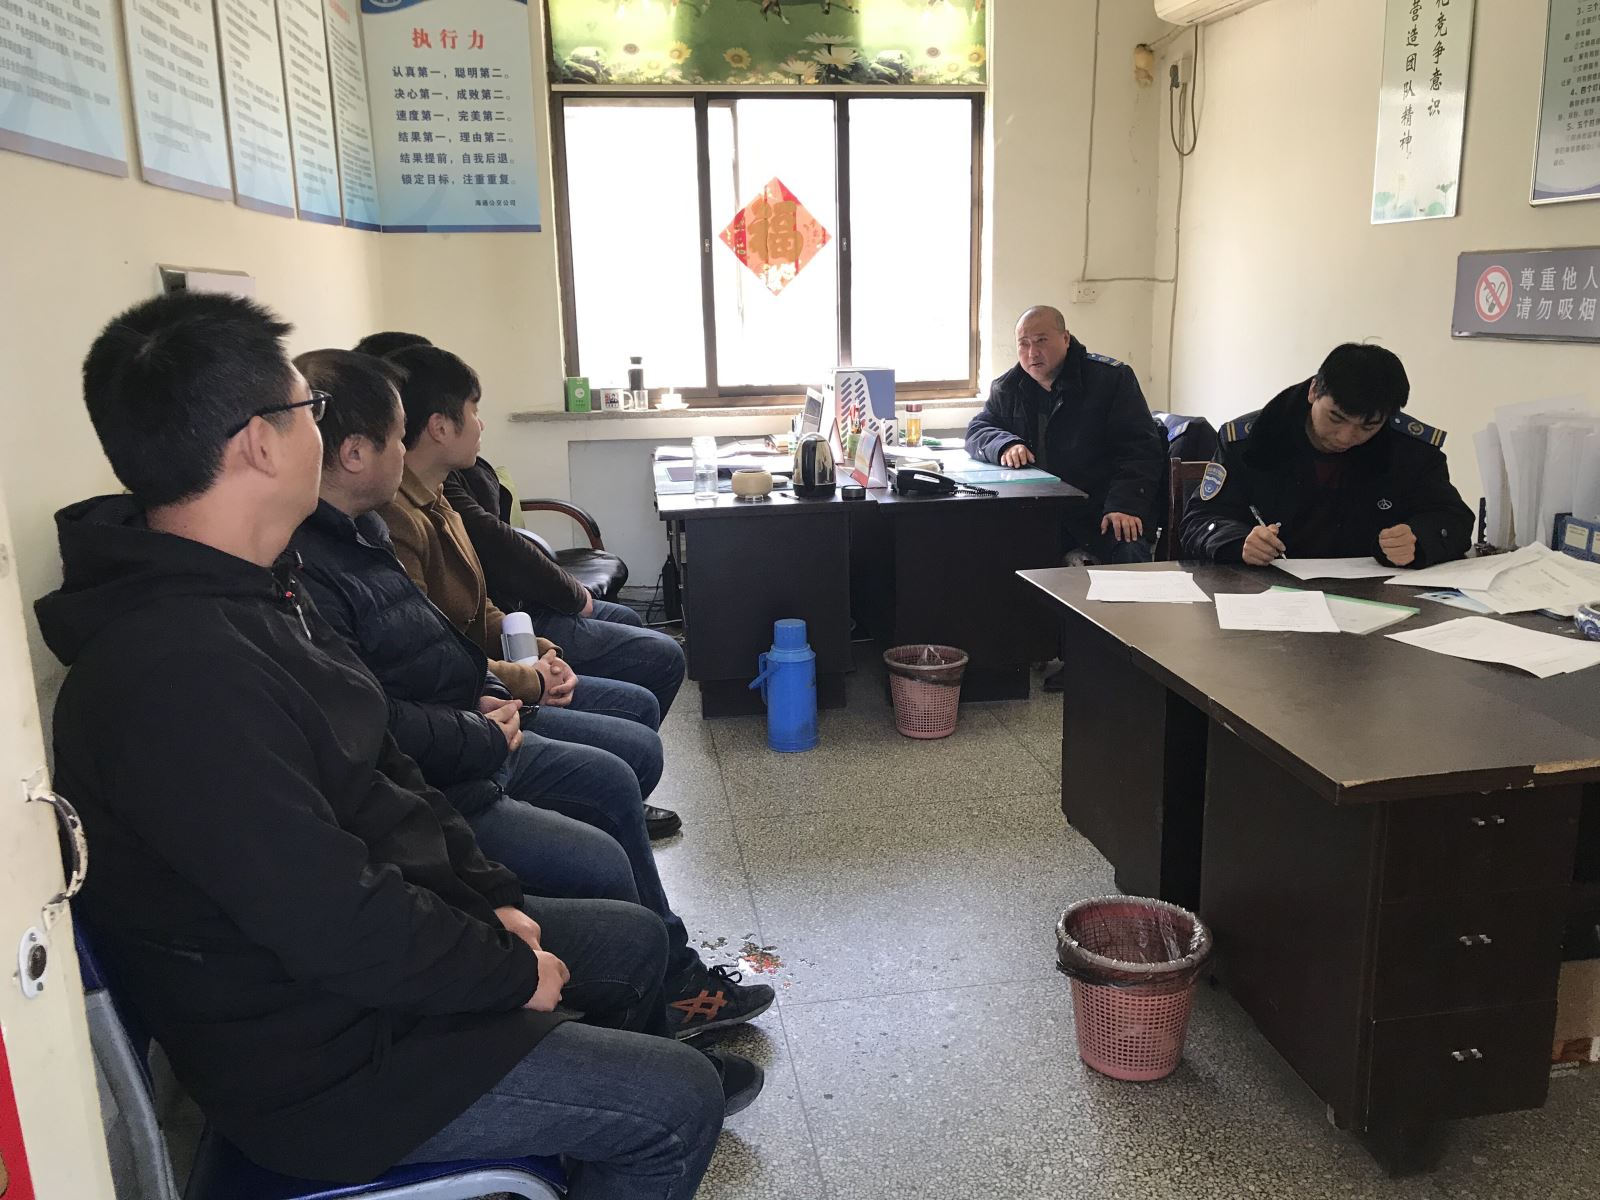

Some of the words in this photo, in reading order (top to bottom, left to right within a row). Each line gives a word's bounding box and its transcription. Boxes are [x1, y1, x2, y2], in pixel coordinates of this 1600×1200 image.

[411, 28, 485, 50] 执行力
[392, 66, 510, 79] 认真第一，聪明第二。
[394, 88, 511, 100] 决心第一，成败第二。
[396, 110, 512, 122] 速度第一，完美第二。
[398, 131, 514, 143] 结果第一，理由第二。
[399, 152, 515, 165] 结果提前，自我后退。
[401, 173, 516, 185] 锁定目标，注重重复。
[1519, 265, 1599, 292] 尊重他人
[1516, 297, 1597, 321] 请勿吸烟
